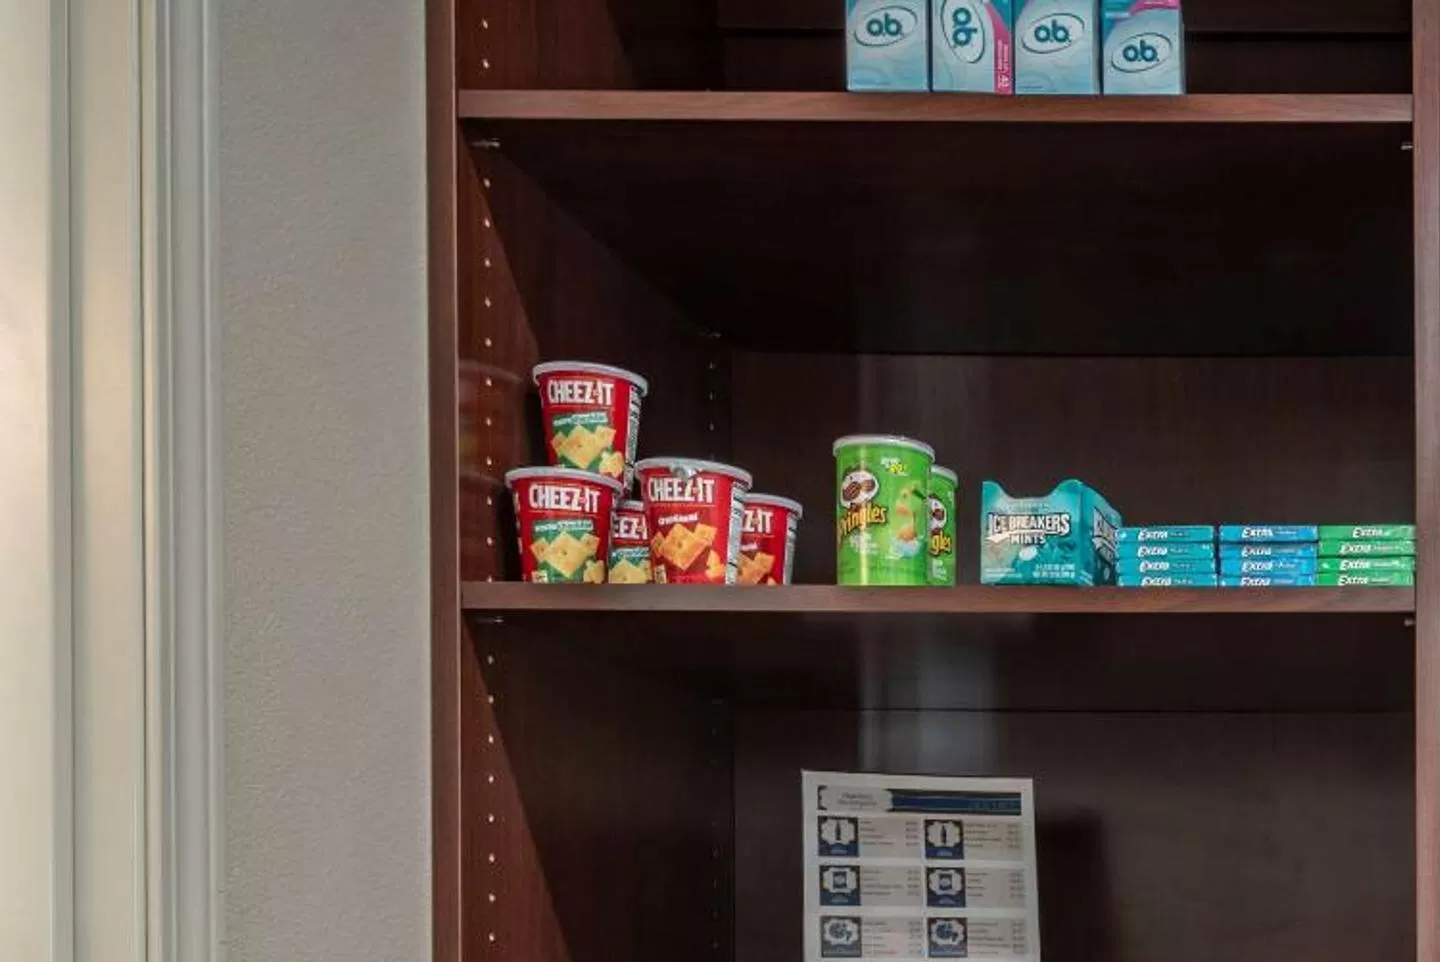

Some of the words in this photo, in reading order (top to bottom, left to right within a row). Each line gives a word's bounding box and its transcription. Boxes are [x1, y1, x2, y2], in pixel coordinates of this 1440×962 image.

[548, 379, 615, 406] CHEEZ-IT
[529, 483, 600, 513] CHEEZ-IT
[648, 476, 715, 504] CHEEZ-IT
[988, 513, 1006, 537] ICE
[1008, 513, 1071, 536] BREAKERS
